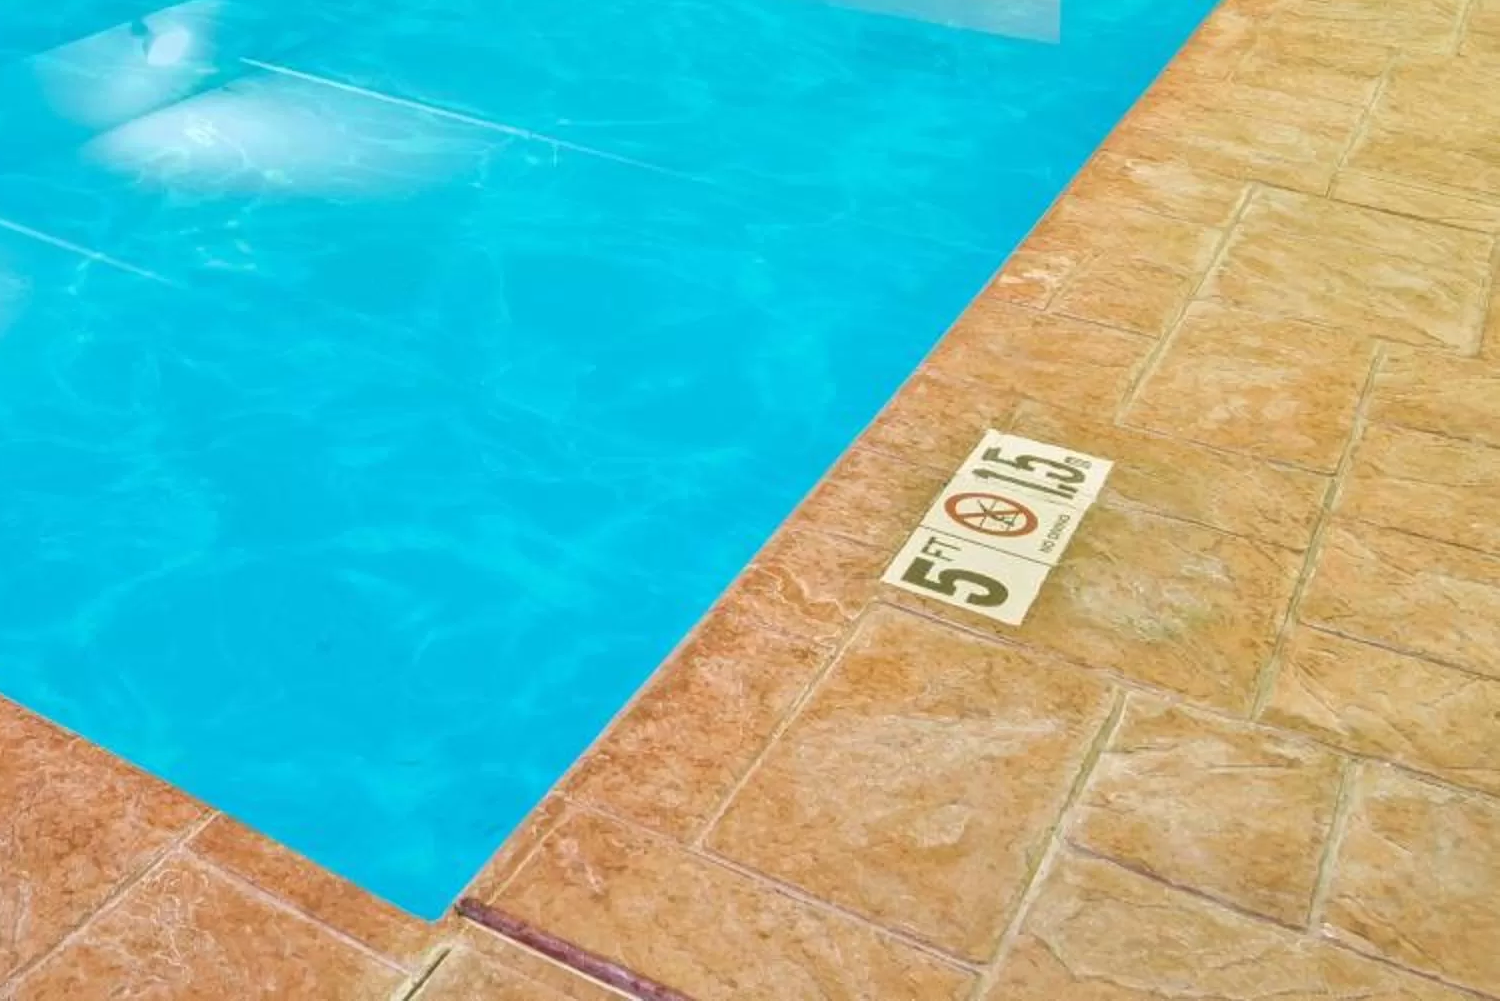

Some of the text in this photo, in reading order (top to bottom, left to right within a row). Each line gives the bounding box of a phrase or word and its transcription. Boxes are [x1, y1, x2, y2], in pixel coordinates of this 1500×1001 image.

[971, 446, 1086, 499] 1.5
[900, 536, 1009, 607] 5 FT
